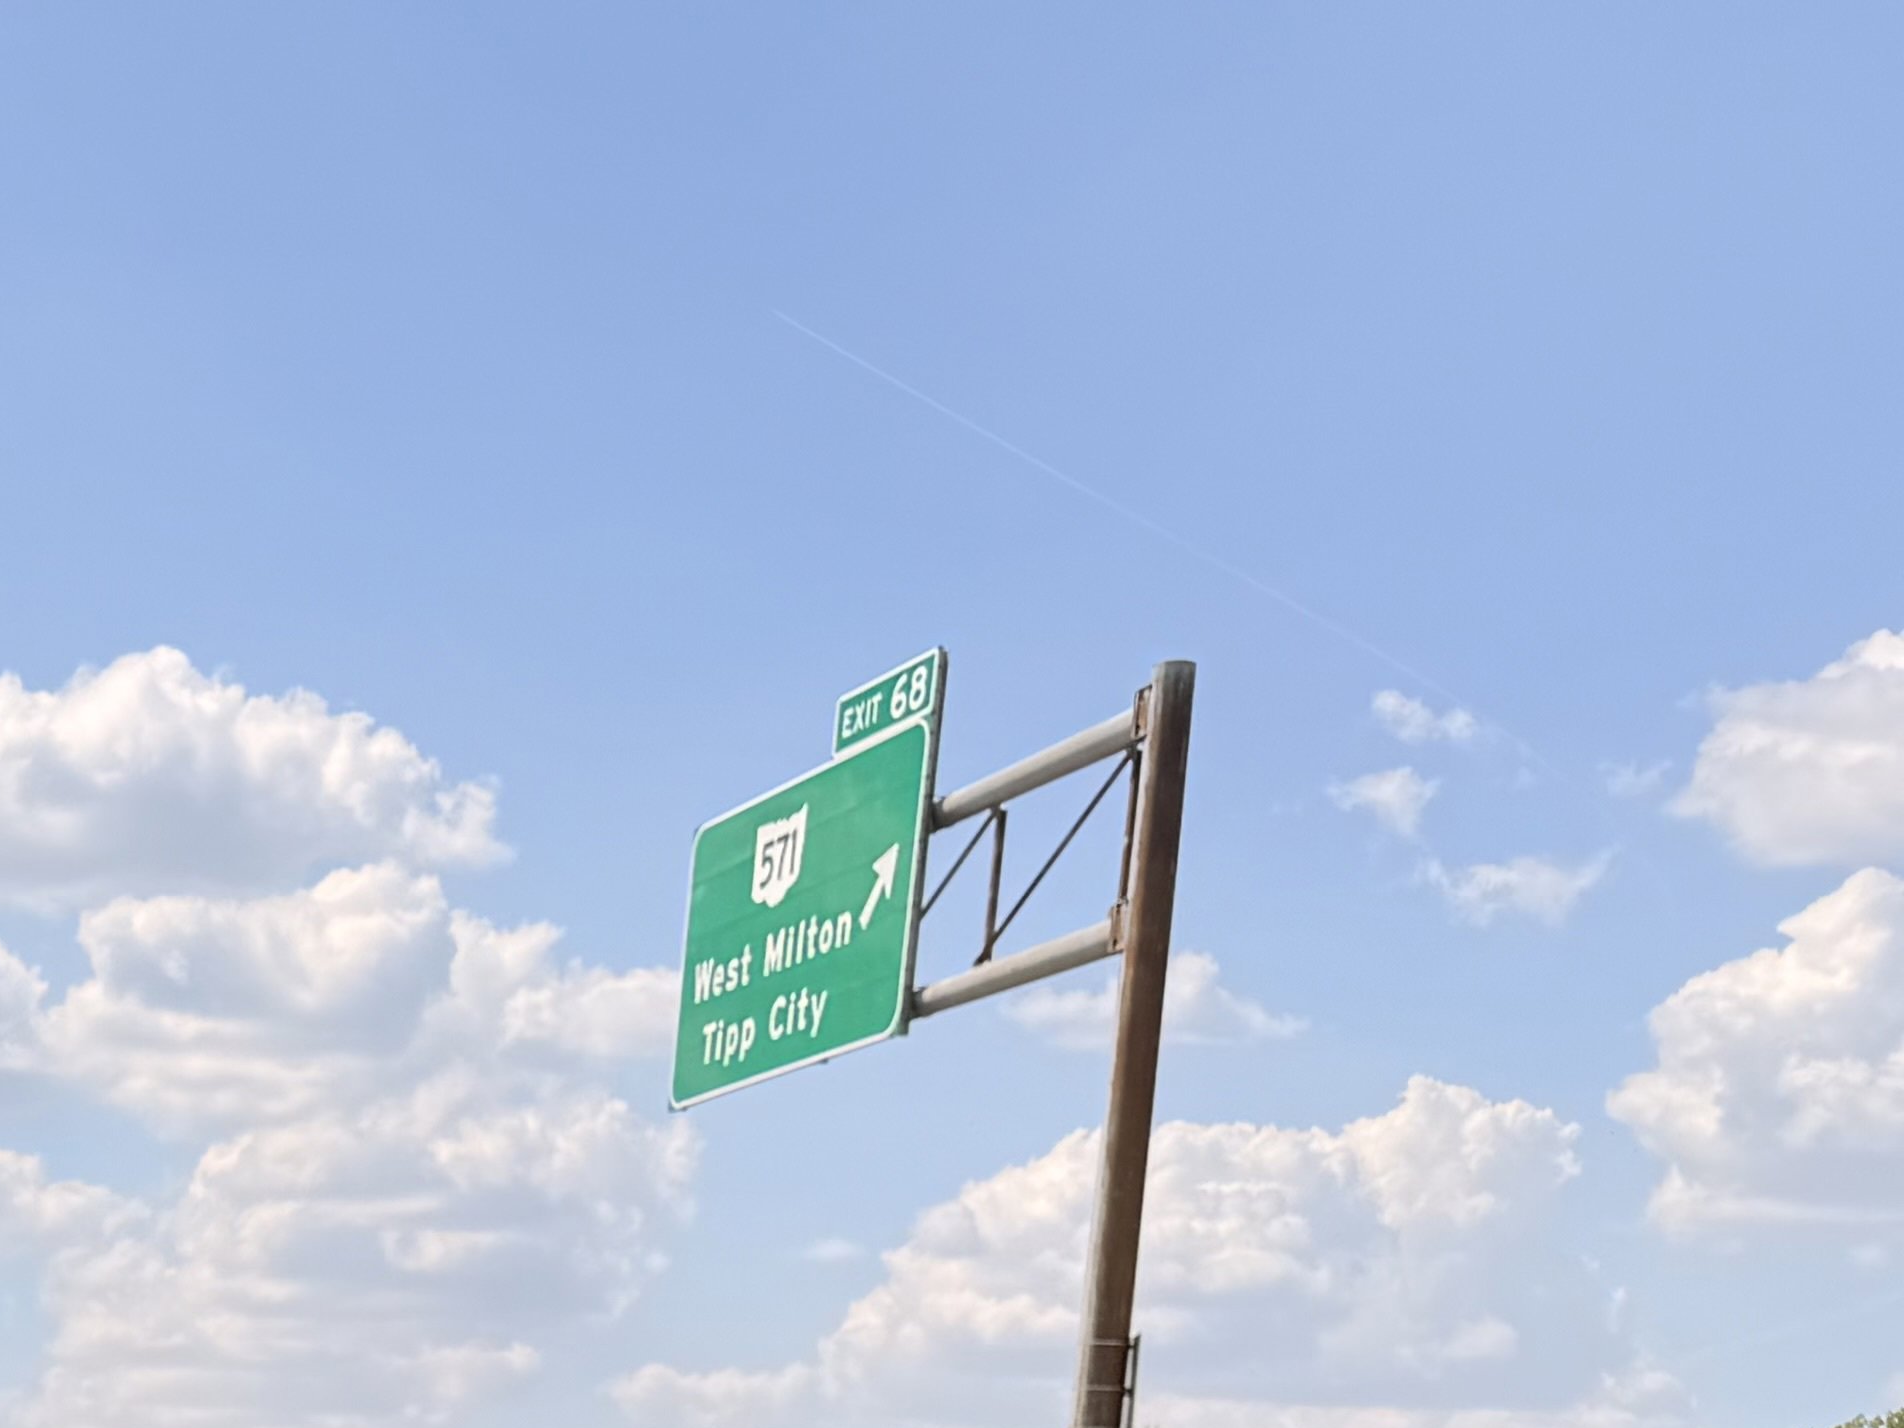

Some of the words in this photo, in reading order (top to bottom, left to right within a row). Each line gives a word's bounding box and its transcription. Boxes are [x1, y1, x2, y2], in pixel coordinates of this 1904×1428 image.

[841, 692, 884, 740] EXIT
[889, 665, 928, 721] 68
[760, 832, 799, 888] 571
[693, 944, 752, 1005] West
[762, 909, 853, 978] Milton
[701, 1018, 756, 1067] Tipp
[768, 990, 829, 1039] City
